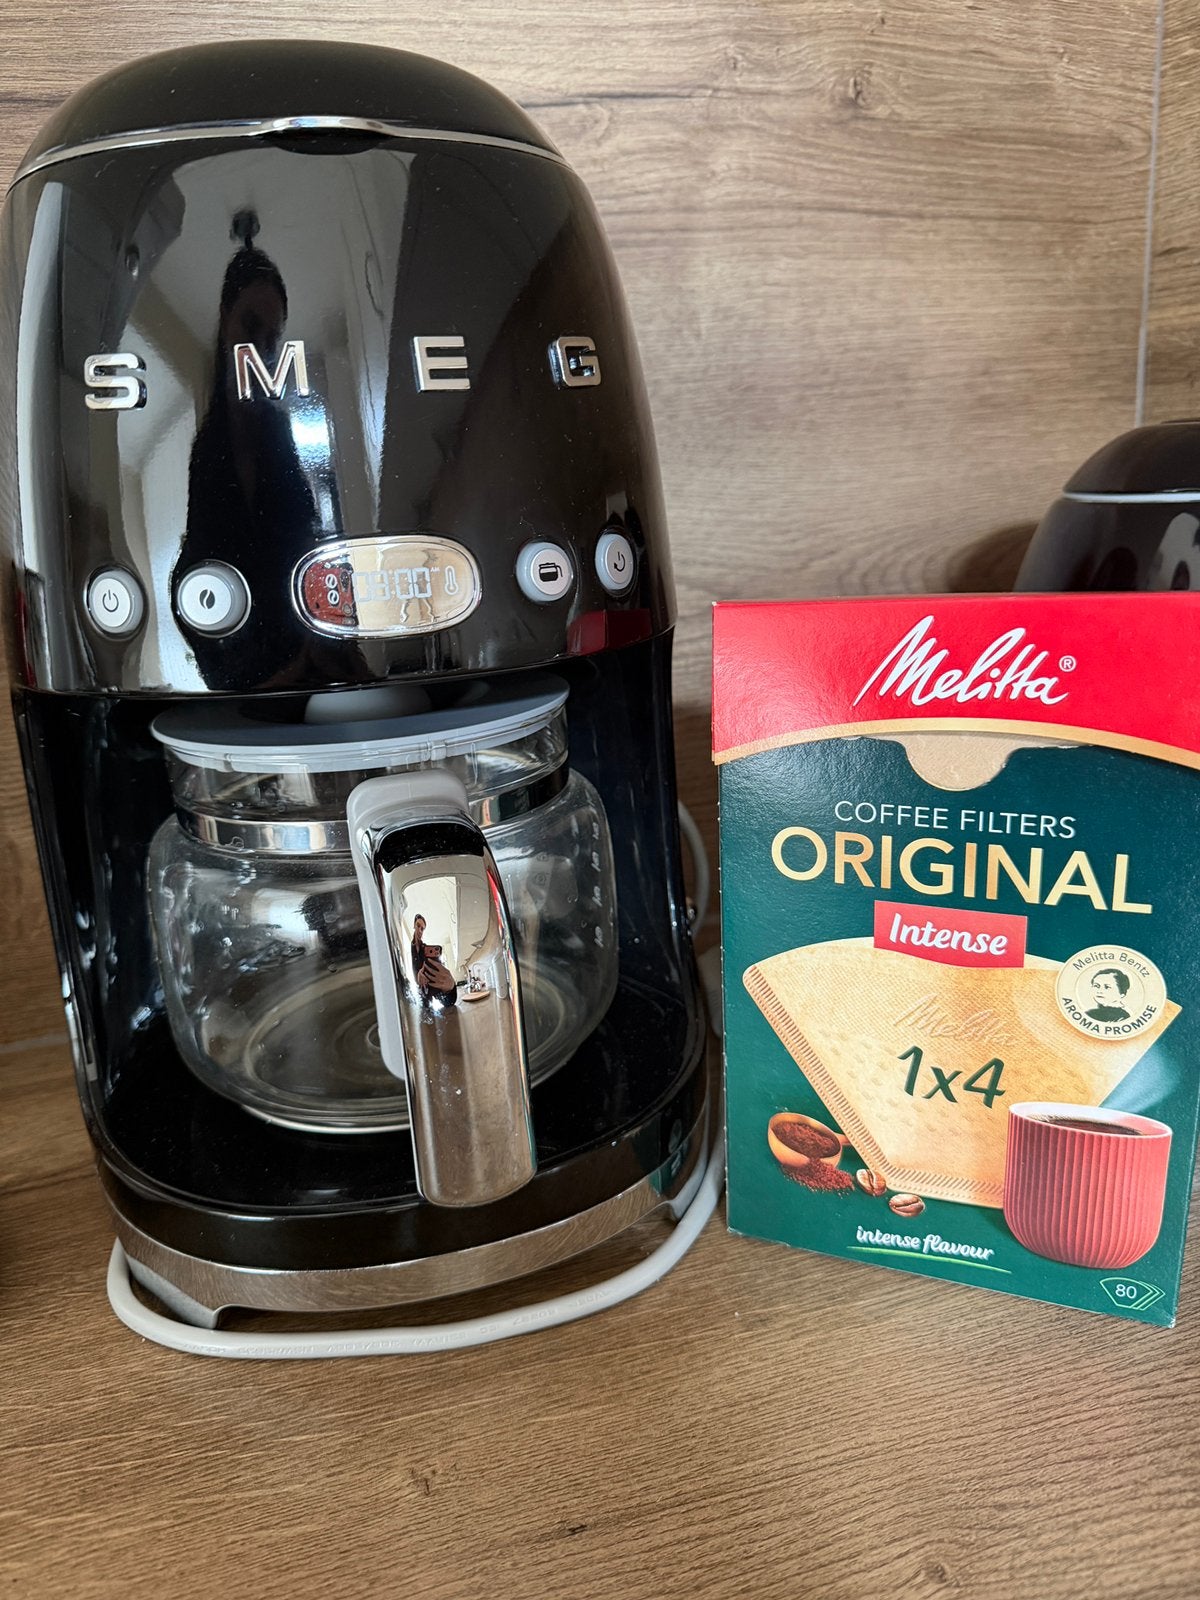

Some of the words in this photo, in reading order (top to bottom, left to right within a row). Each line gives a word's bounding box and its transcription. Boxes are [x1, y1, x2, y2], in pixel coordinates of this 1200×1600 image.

[84, 336, 602, 410] SMEG
[834, 800, 948, 829] COFFEE
[960, 809, 1077, 839] FILTERS
[770, 826, 1153, 914] ORIGINAL
[888, 912, 1009, 956] Intense
[1072, 951, 1115, 971] Melitta
[1119, 952, 1151, 978] Bentz
[1062, 997, 1101, 1033] AROMA
[1104, 1004, 1158, 1035] PROMISE
[897, 1045, 1007, 1109] 1x4
[856, 1225, 921, 1249] intense
[921, 1233, 995, 1261] flavour
[1114, 1283, 1138, 1300] 80
